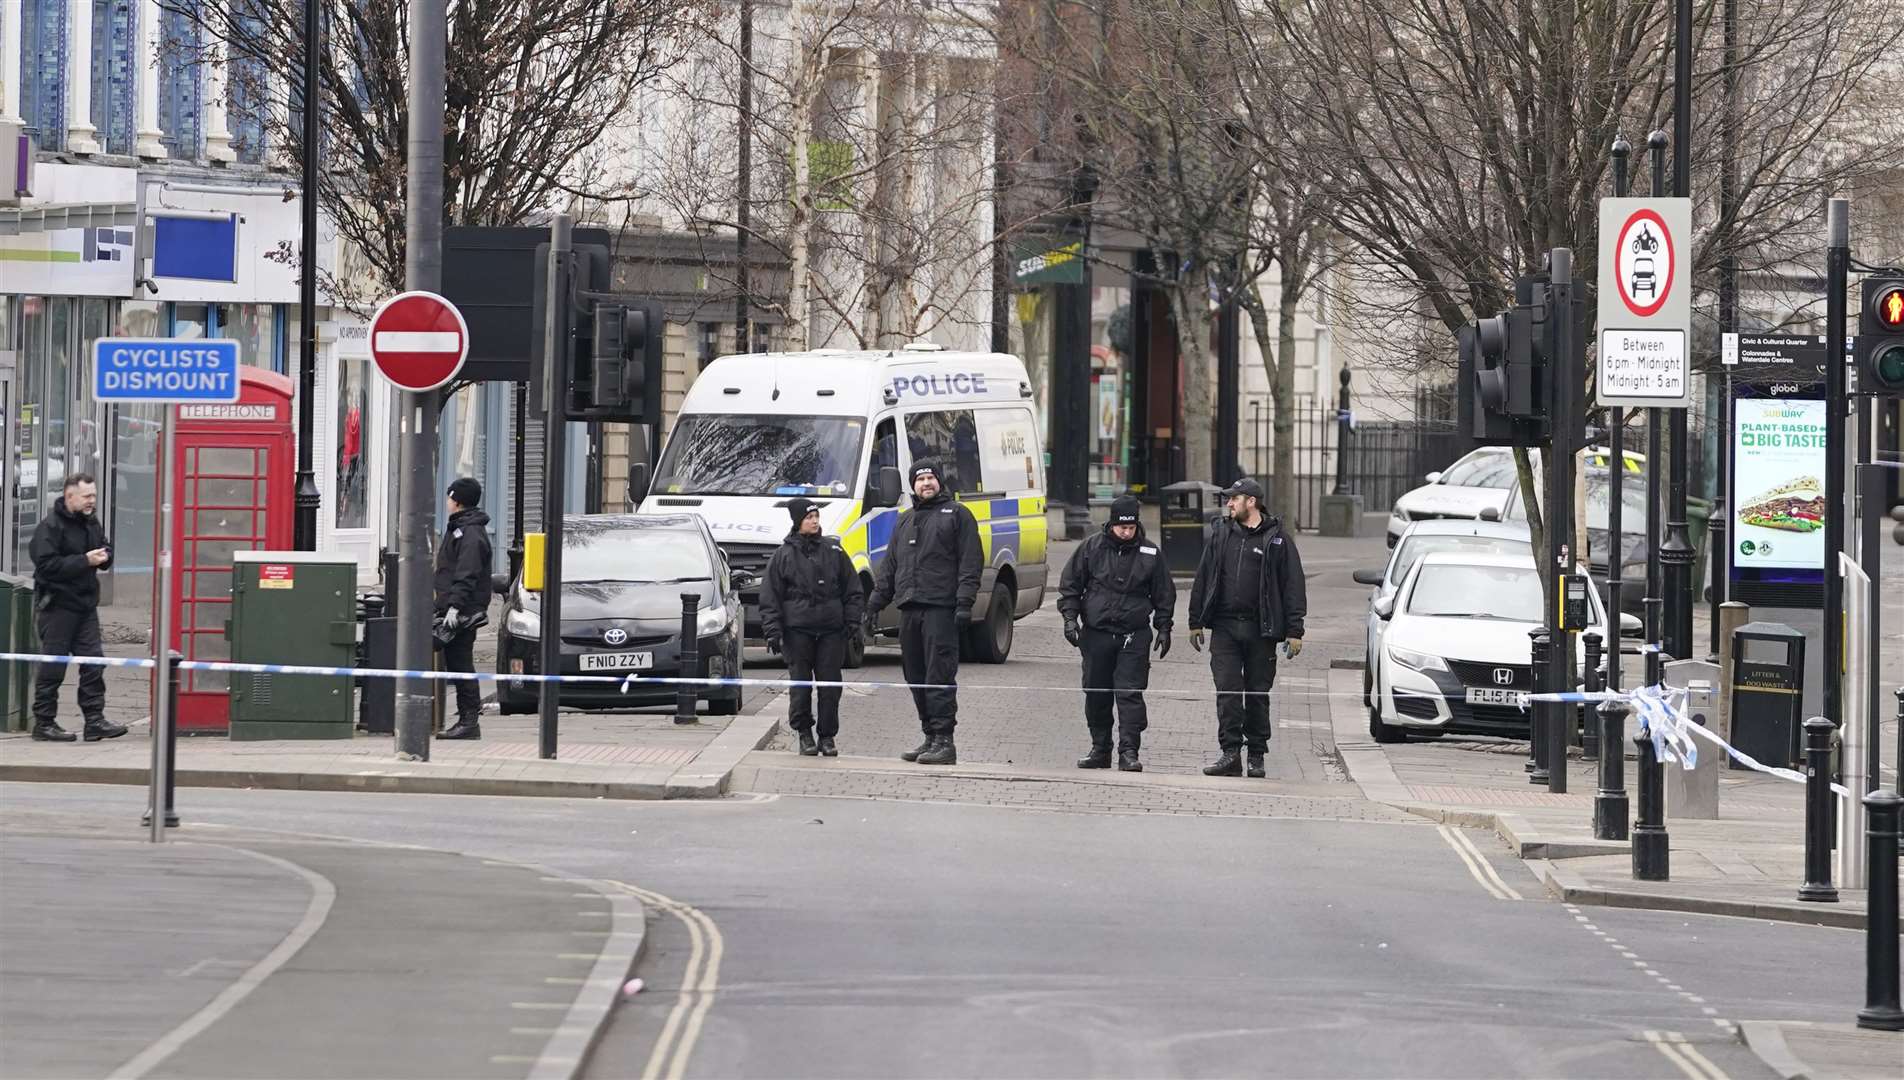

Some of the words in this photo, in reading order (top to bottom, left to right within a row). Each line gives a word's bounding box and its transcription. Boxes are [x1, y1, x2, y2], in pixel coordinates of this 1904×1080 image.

[346, 326, 369, 339] APPOINTMEN
[1623, 338, 1664, 351] Between
[1762, 338, 1785, 346] Cultural
[112, 349, 221, 368] CYCLISTS
[1637, 356, 1680, 372] Midnight
[104, 371, 230, 391] DISMOUNT
[893, 373, 987, 397] POLICE
[1607, 374, 1649, 389] Midnight
[1770, 383, 1799, 396] global
[186, 405, 272, 418] TELEPHONE
[1763, 410, 1805, 418] SUBWAY
[1741, 423, 1818, 433] PLANT-BASED
[1757, 433, 1782, 448] BIG
[1784, 434, 1826, 449] TASTE
[711, 523, 773, 533] LICE
[587, 655, 616, 668] FN10
[619, 654, 645, 667] ZZY
[1474, 689, 1503, 703] FL15
